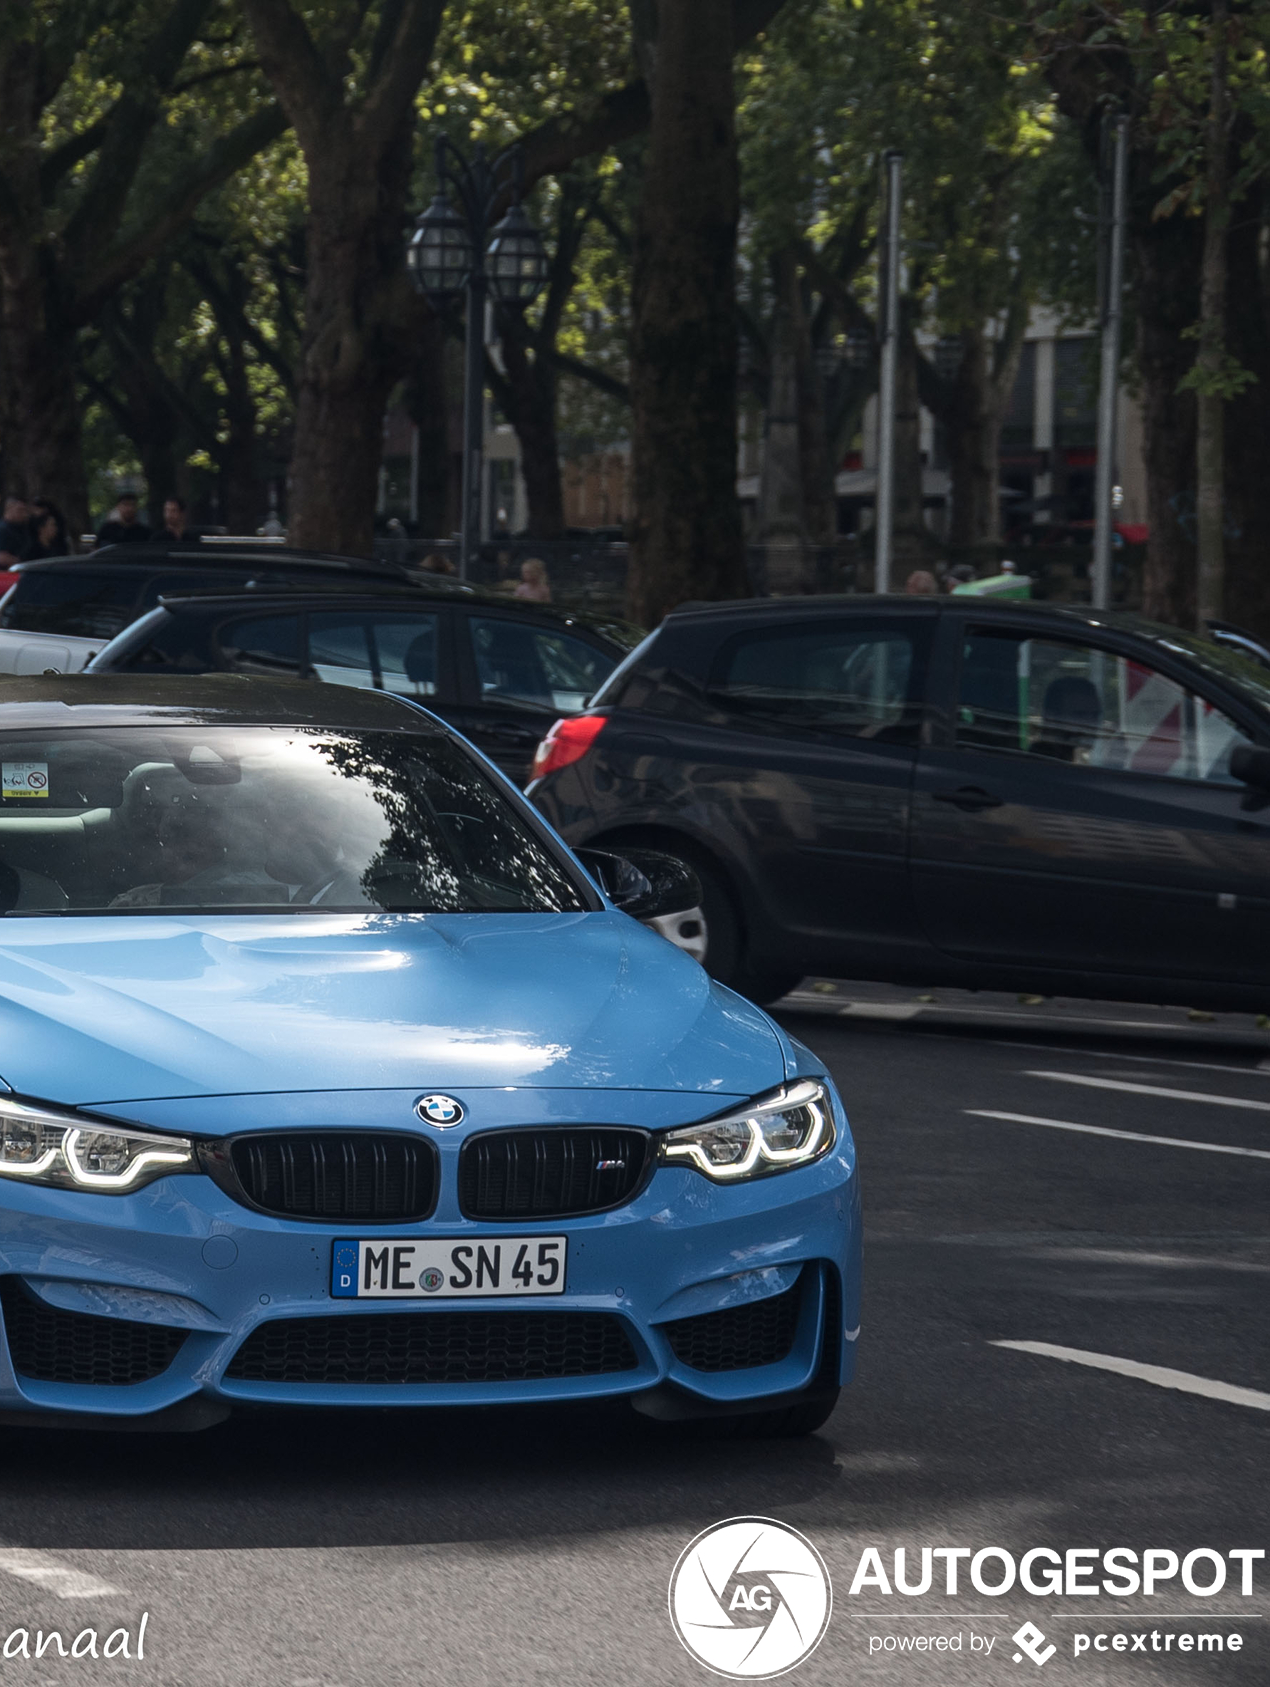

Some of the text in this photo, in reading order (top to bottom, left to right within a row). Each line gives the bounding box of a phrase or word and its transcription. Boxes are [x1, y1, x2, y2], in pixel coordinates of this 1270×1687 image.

[341, 1243, 559, 1289] D ME SN 45
